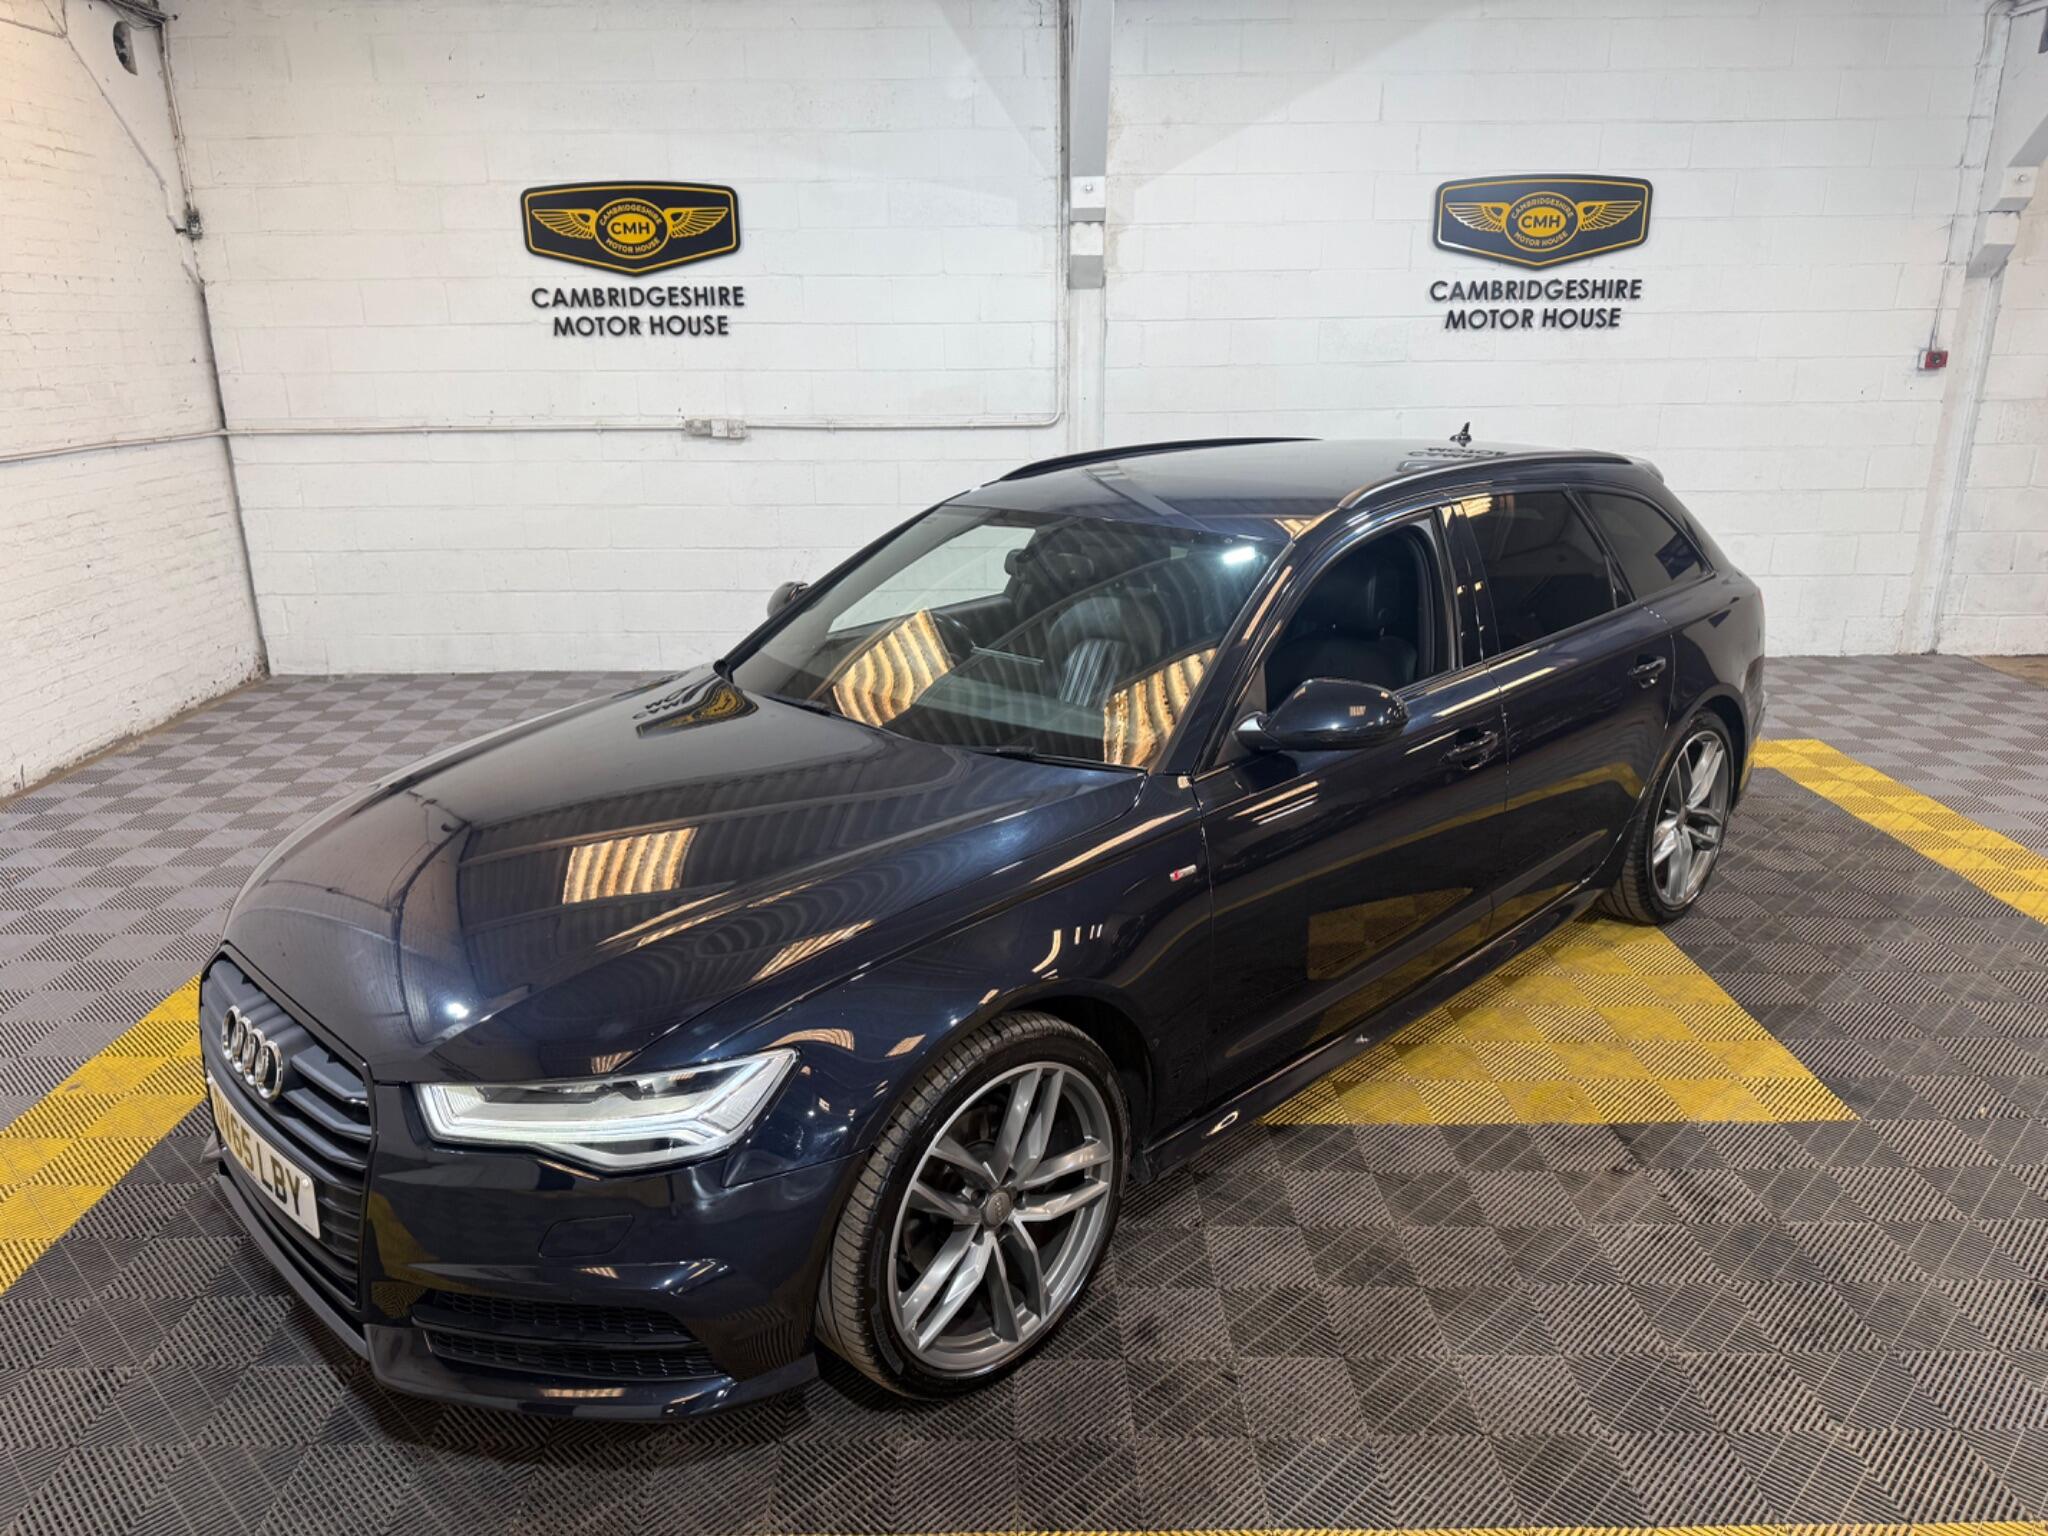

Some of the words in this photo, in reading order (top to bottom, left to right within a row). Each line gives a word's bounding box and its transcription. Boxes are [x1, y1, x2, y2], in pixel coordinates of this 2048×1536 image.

[599, 204, 663, 226] CAMBRIDGESHIRE
[1511, 197, 1575, 220] CAMBRIDGESHIRE
[611, 221, 650, 235] CMH
[1521, 215, 1561, 229] CMH
[605, 238, 634, 254] MOTOR
[634, 238, 661, 254] HOUSE
[1514, 231, 1540, 247] MOTOR
[1541, 231, 1568, 247] HOUSE
[532, 286, 745, 308] CAMBRIDGESHIRE
[1430, 279, 1643, 302] CAMBRIDGESHIRE
[554, 316, 641, 337] MOTOR
[650, 315, 729, 336] HOUSE
[1445, 307, 1533, 330] MOTOR
[1542, 307, 1621, 329] HOUSE
[256, 1141, 300, 1217] LBY
